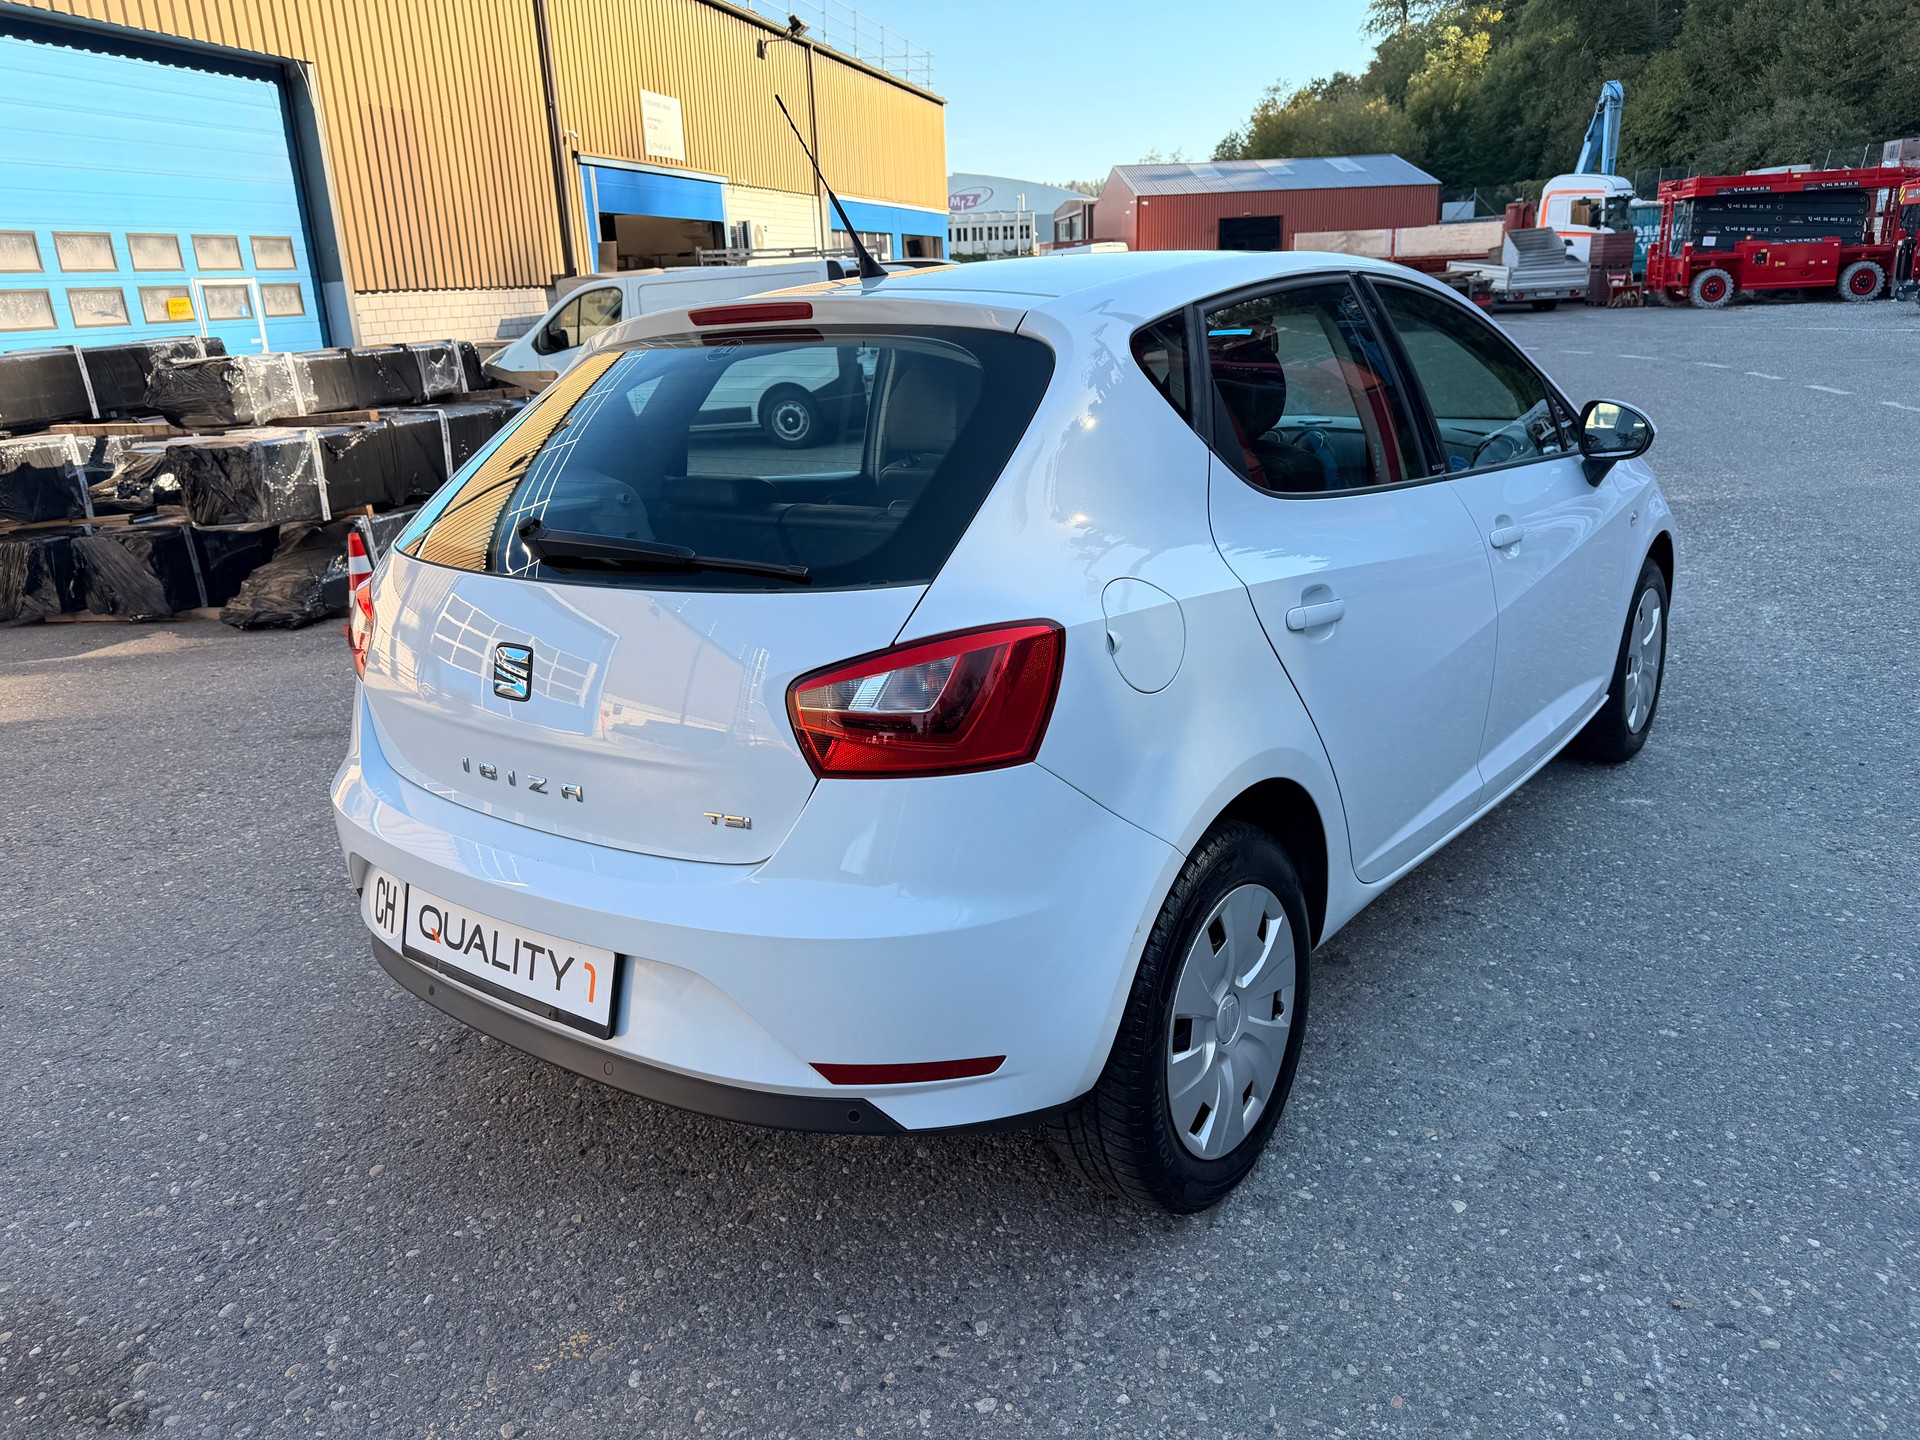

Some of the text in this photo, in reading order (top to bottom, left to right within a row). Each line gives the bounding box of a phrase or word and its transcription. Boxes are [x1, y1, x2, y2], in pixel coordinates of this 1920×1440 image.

[462, 756, 584, 802] IBIZA
[703, 811, 752, 830] TSI
[375, 876, 397, 934] CH
